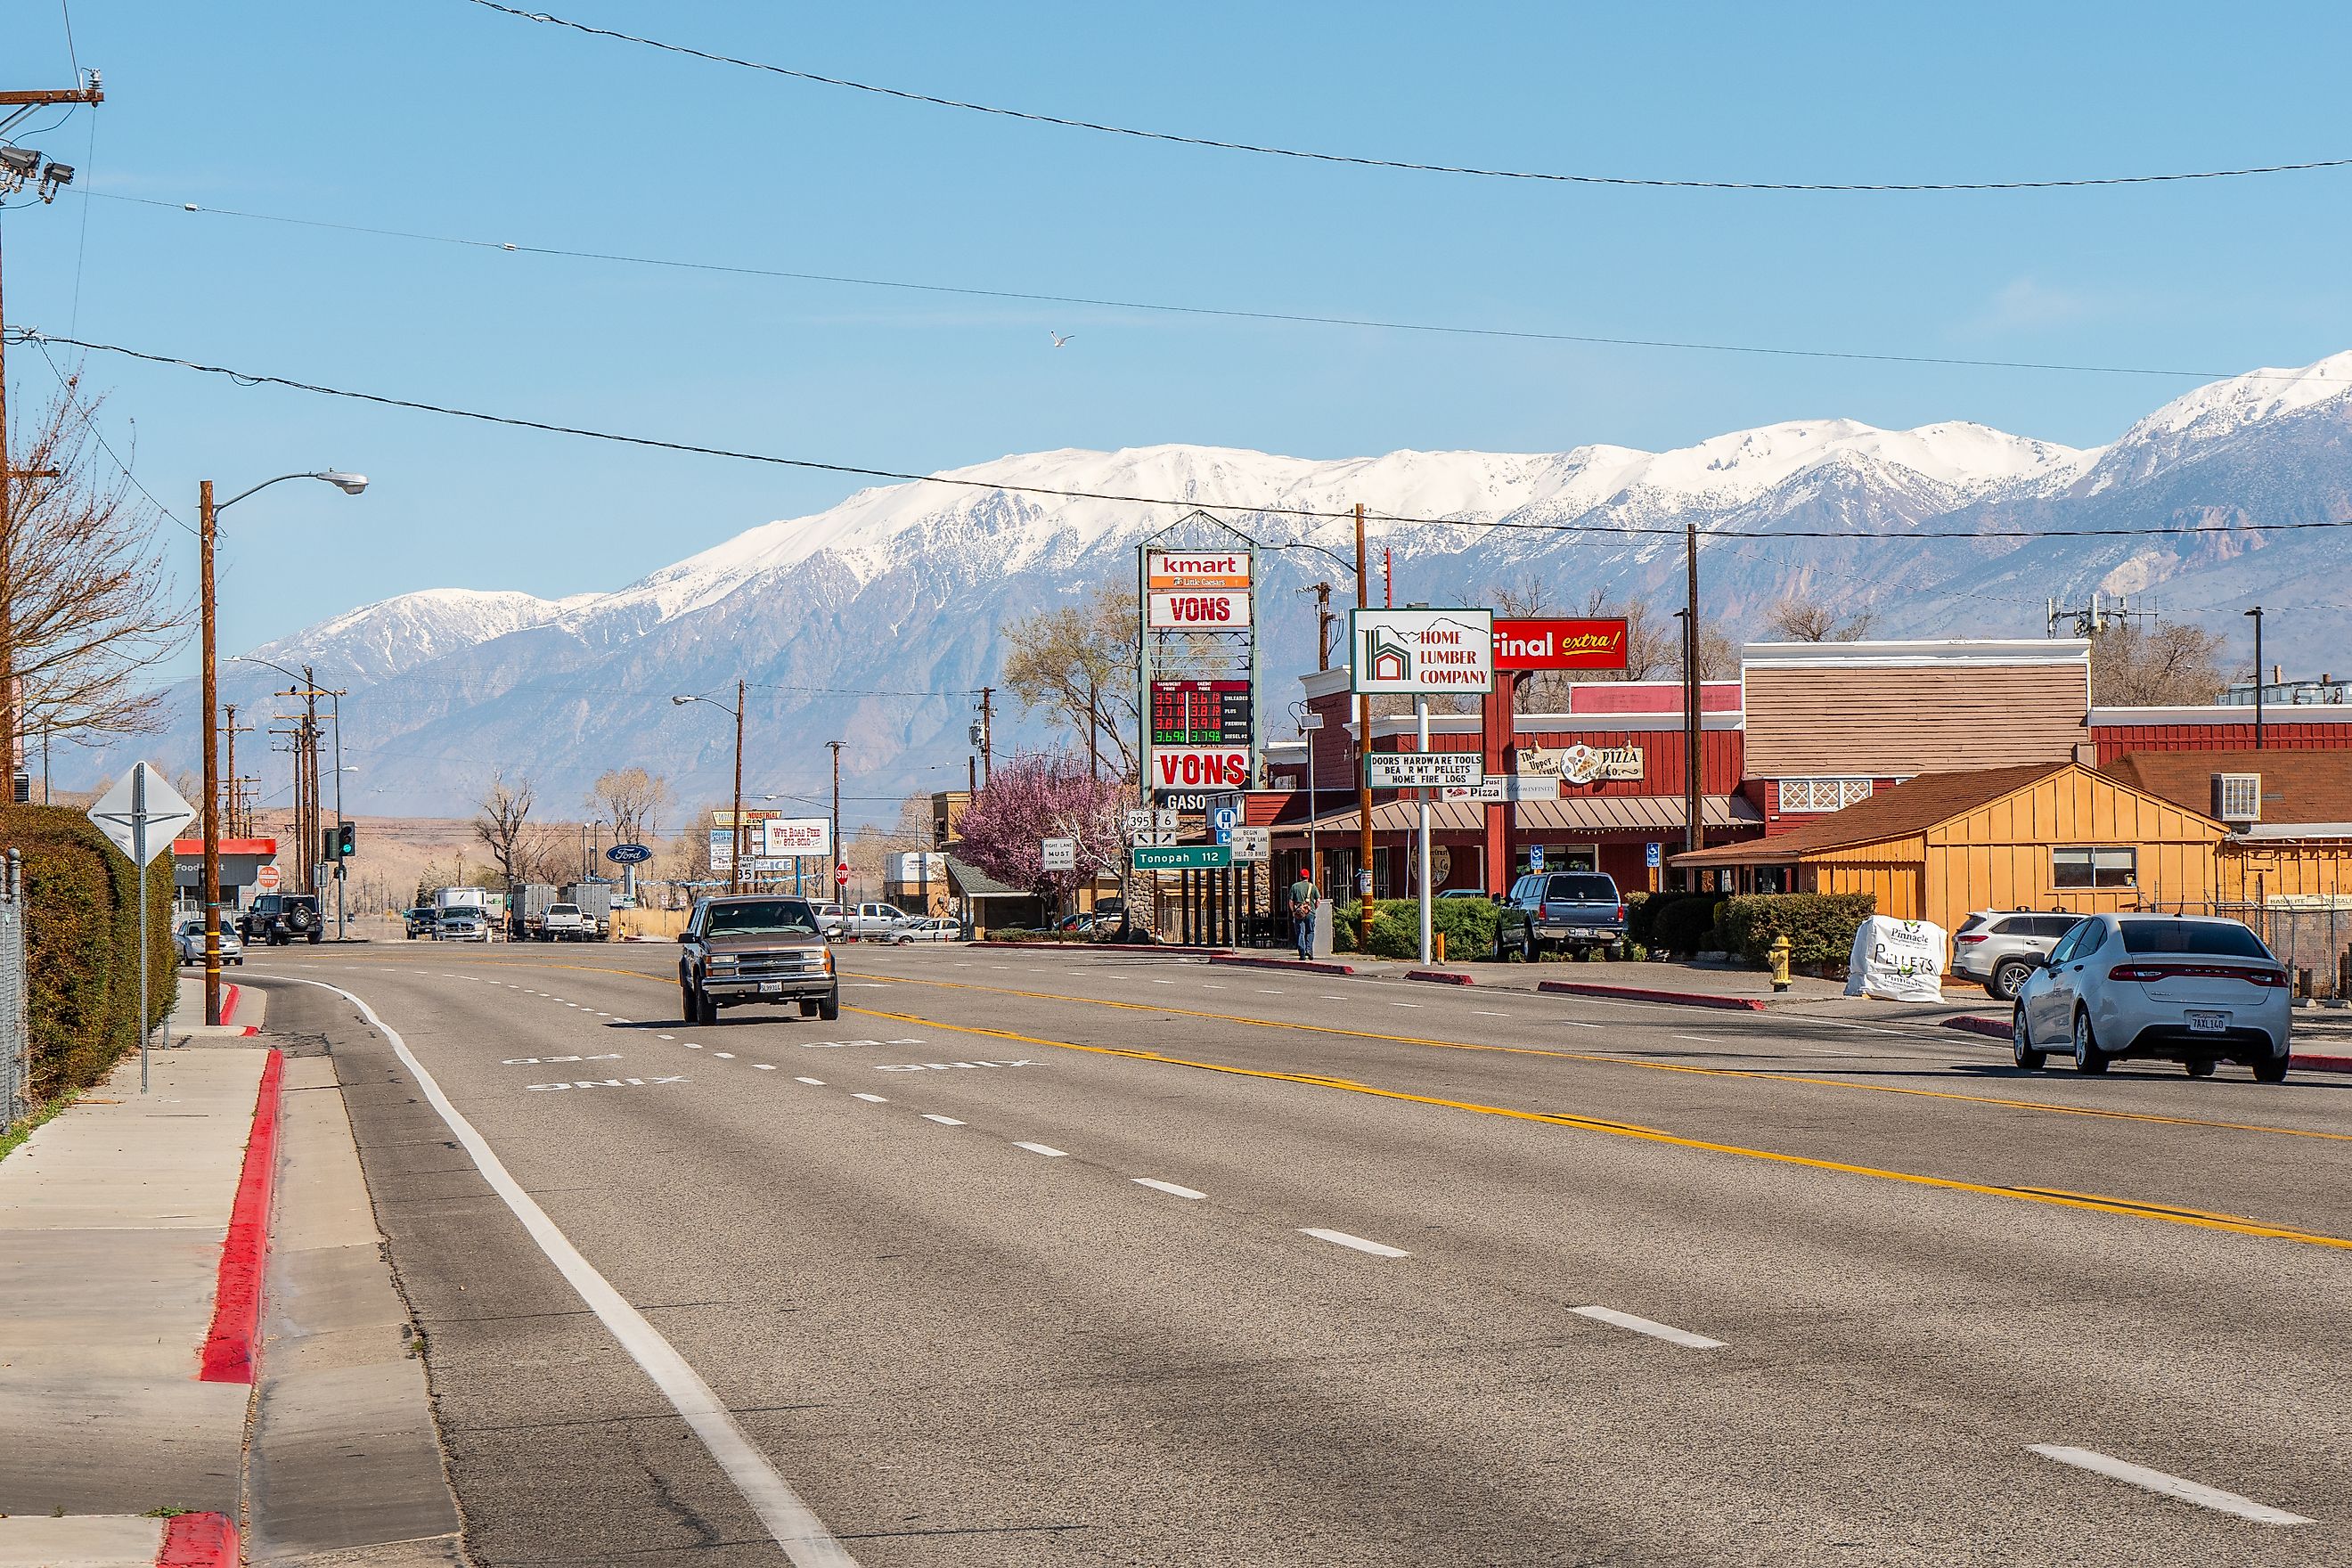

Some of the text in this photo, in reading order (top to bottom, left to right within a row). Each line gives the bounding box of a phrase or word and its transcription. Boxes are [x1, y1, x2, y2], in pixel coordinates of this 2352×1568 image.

[1164, 557, 1237, 573] kmart
[1183, 577, 1226, 586] Little Caesars
[1170, 597, 1230, 622] VONS
[1420, 630, 1463, 645] HOME
[1562, 630, 1621, 650] extra!
[1420, 650, 1477, 665] LUMBER
[1419, 669, 1488, 684] COMPANY
[1372, 755, 1482, 765] DOORS HARDWARE TOOLS
[1519, 751, 1536, 763] The
[1601, 750, 1639, 764] PIZZA
[1159, 754, 1245, 786] VONS
[1434, 765, 1471, 774] PELLETS
[1528, 757, 1552, 772] Upper
[1392, 775, 1466, 784] HOME FIRE LOGS
[1469, 787, 1499, 797] Pizza
[1130, 816, 1149, 827] 395
[1164, 815, 1172, 826] 6
[615, 848, 641, 860] Ford
[1139, 852, 1219, 864] Tonopah 112
[175, 863, 200, 872] Food
[770, 861, 791, 870] ICE
[738, 869, 752, 880] 35
[1891, 927, 1929, 943] Pinnacle
[1874, 943, 1934, 972] PELLETS
[2192, 1018, 2224, 1029] 7AXL140
